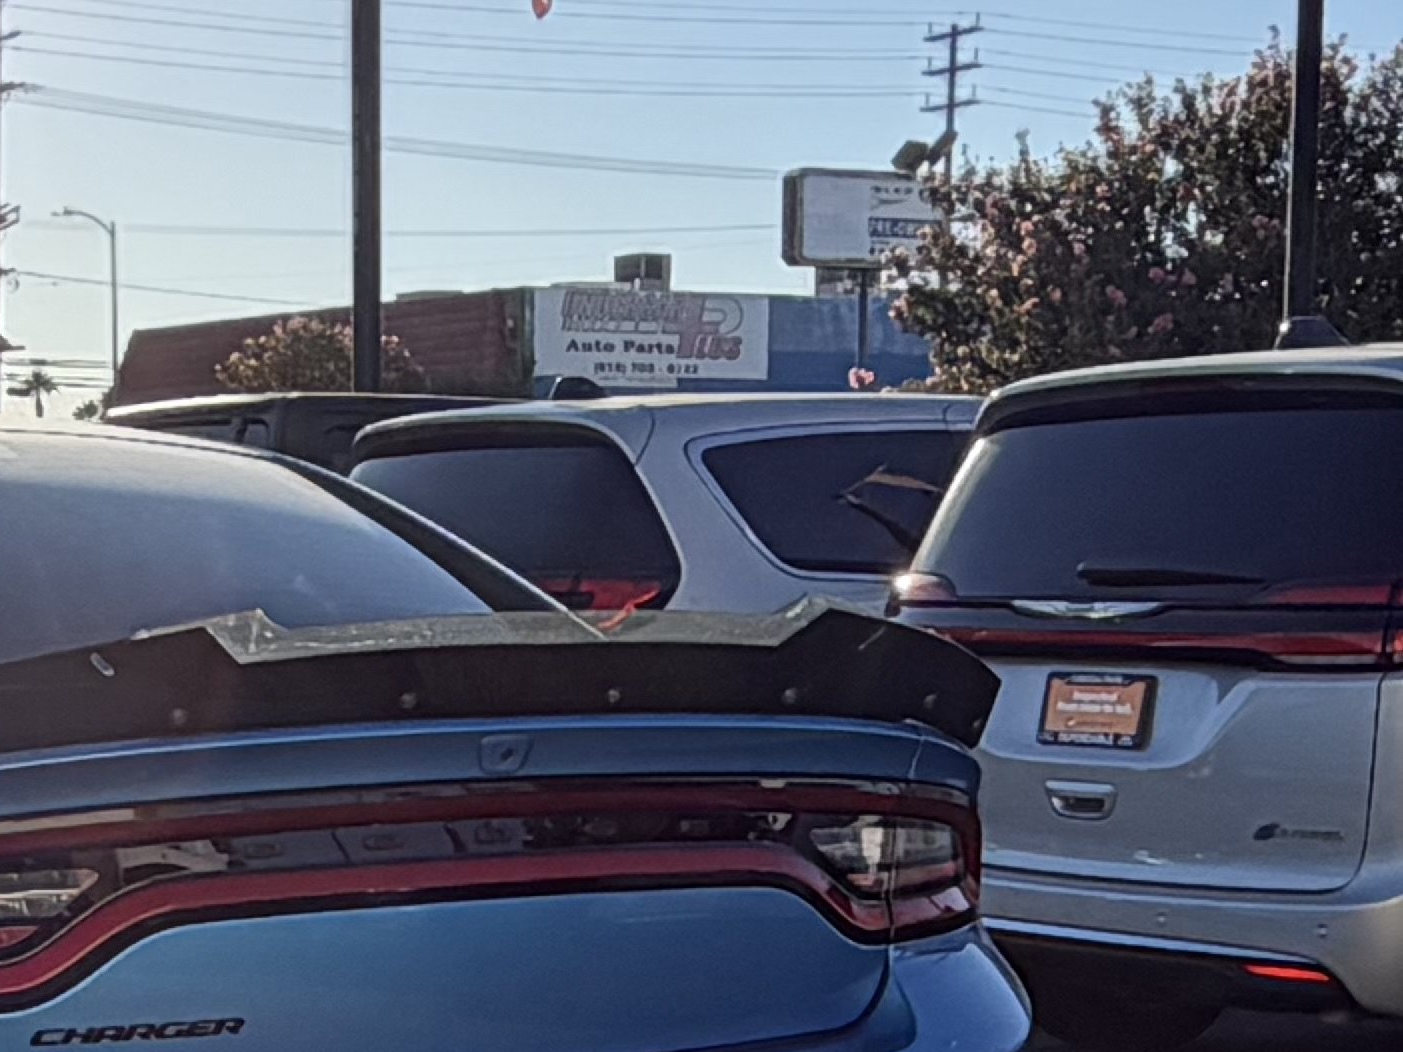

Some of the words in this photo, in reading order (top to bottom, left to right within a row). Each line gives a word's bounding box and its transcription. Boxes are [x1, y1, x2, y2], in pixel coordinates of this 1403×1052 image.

[565, 338, 616, 354] Auto
[623, 339, 676, 355] Parts
[29, 1017, 246, 1047] CHARGER
